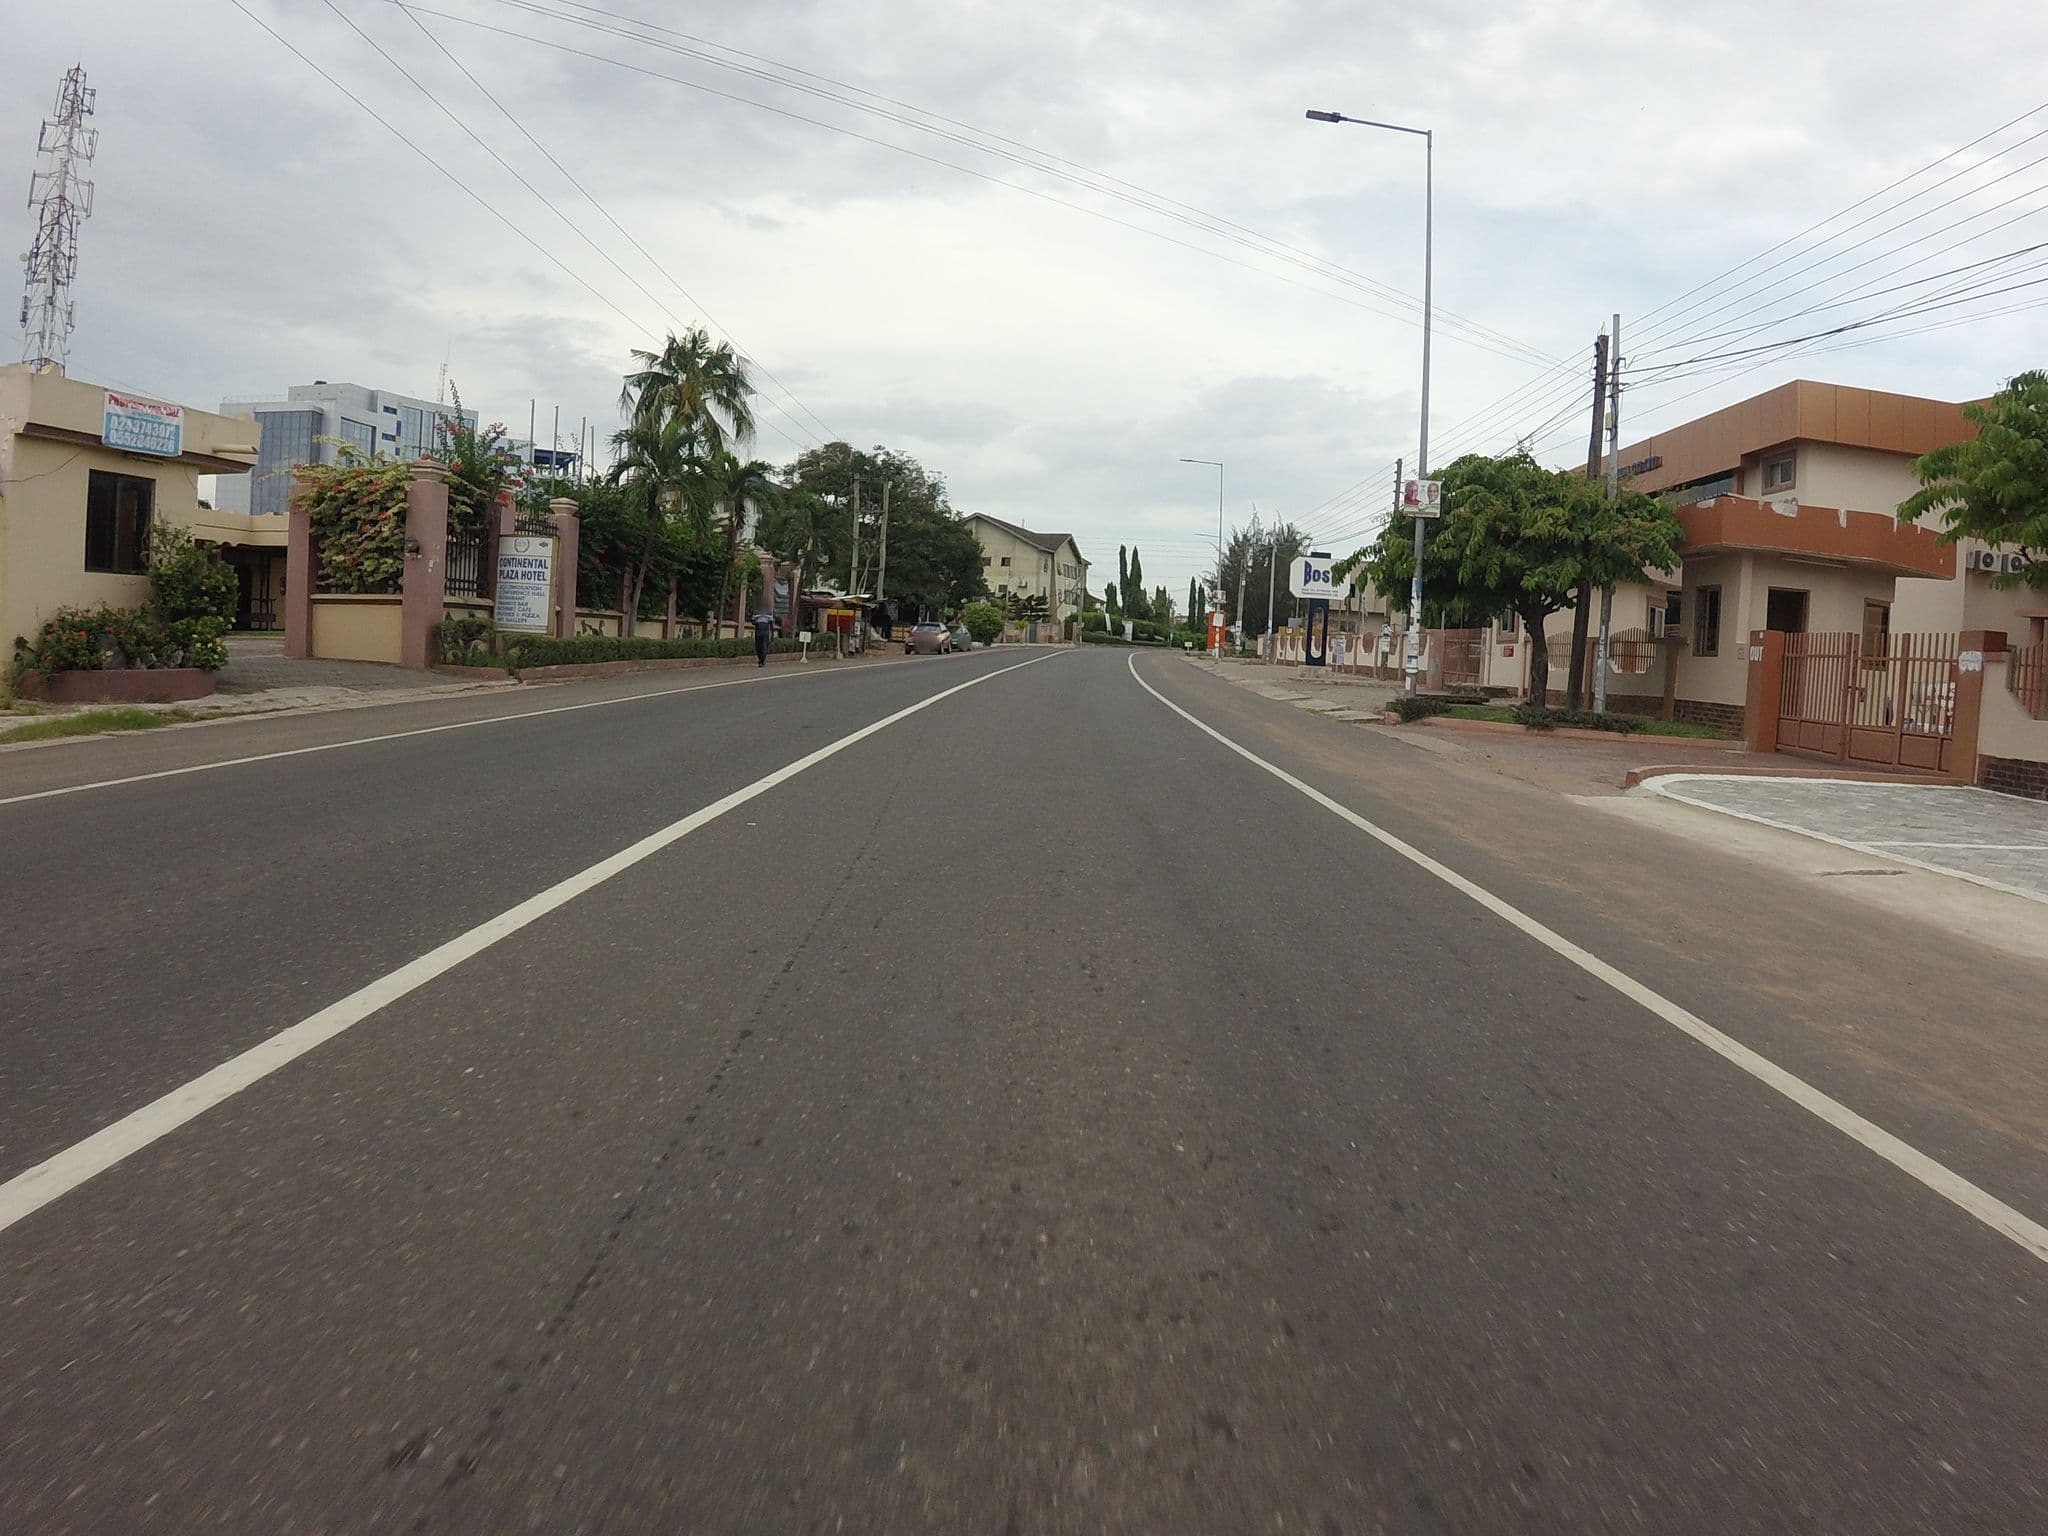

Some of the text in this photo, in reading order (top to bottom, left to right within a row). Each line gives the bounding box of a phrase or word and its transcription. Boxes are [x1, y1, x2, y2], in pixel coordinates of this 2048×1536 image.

[499, 557, 549, 570] CONTINENTAL
[498, 569, 548, 582] PLAZA HOTEL
